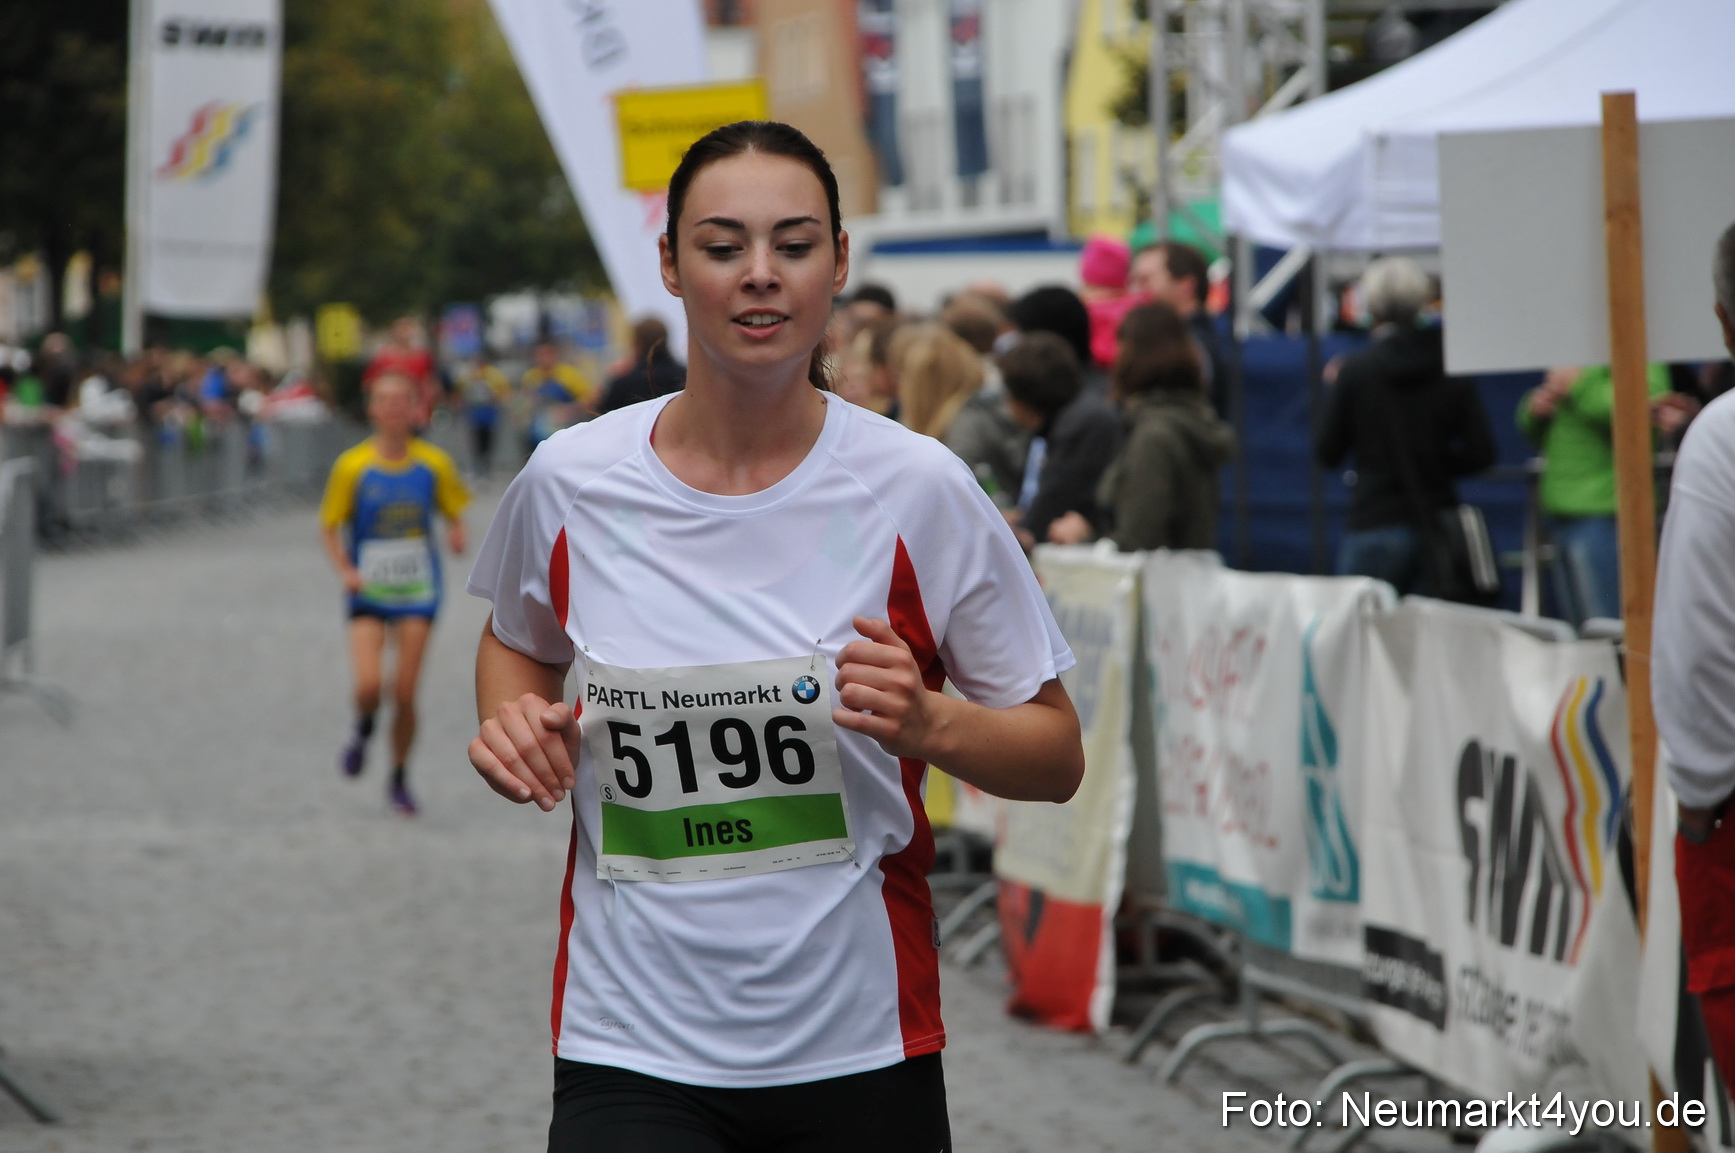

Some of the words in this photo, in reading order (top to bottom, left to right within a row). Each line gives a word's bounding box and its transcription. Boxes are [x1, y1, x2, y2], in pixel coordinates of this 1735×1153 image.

[587, 683, 656, 710] PARTL
[662, 685, 782, 709] Neumarkt
[606, 715, 815, 799] 5196
[683, 817, 753, 847] Ines
